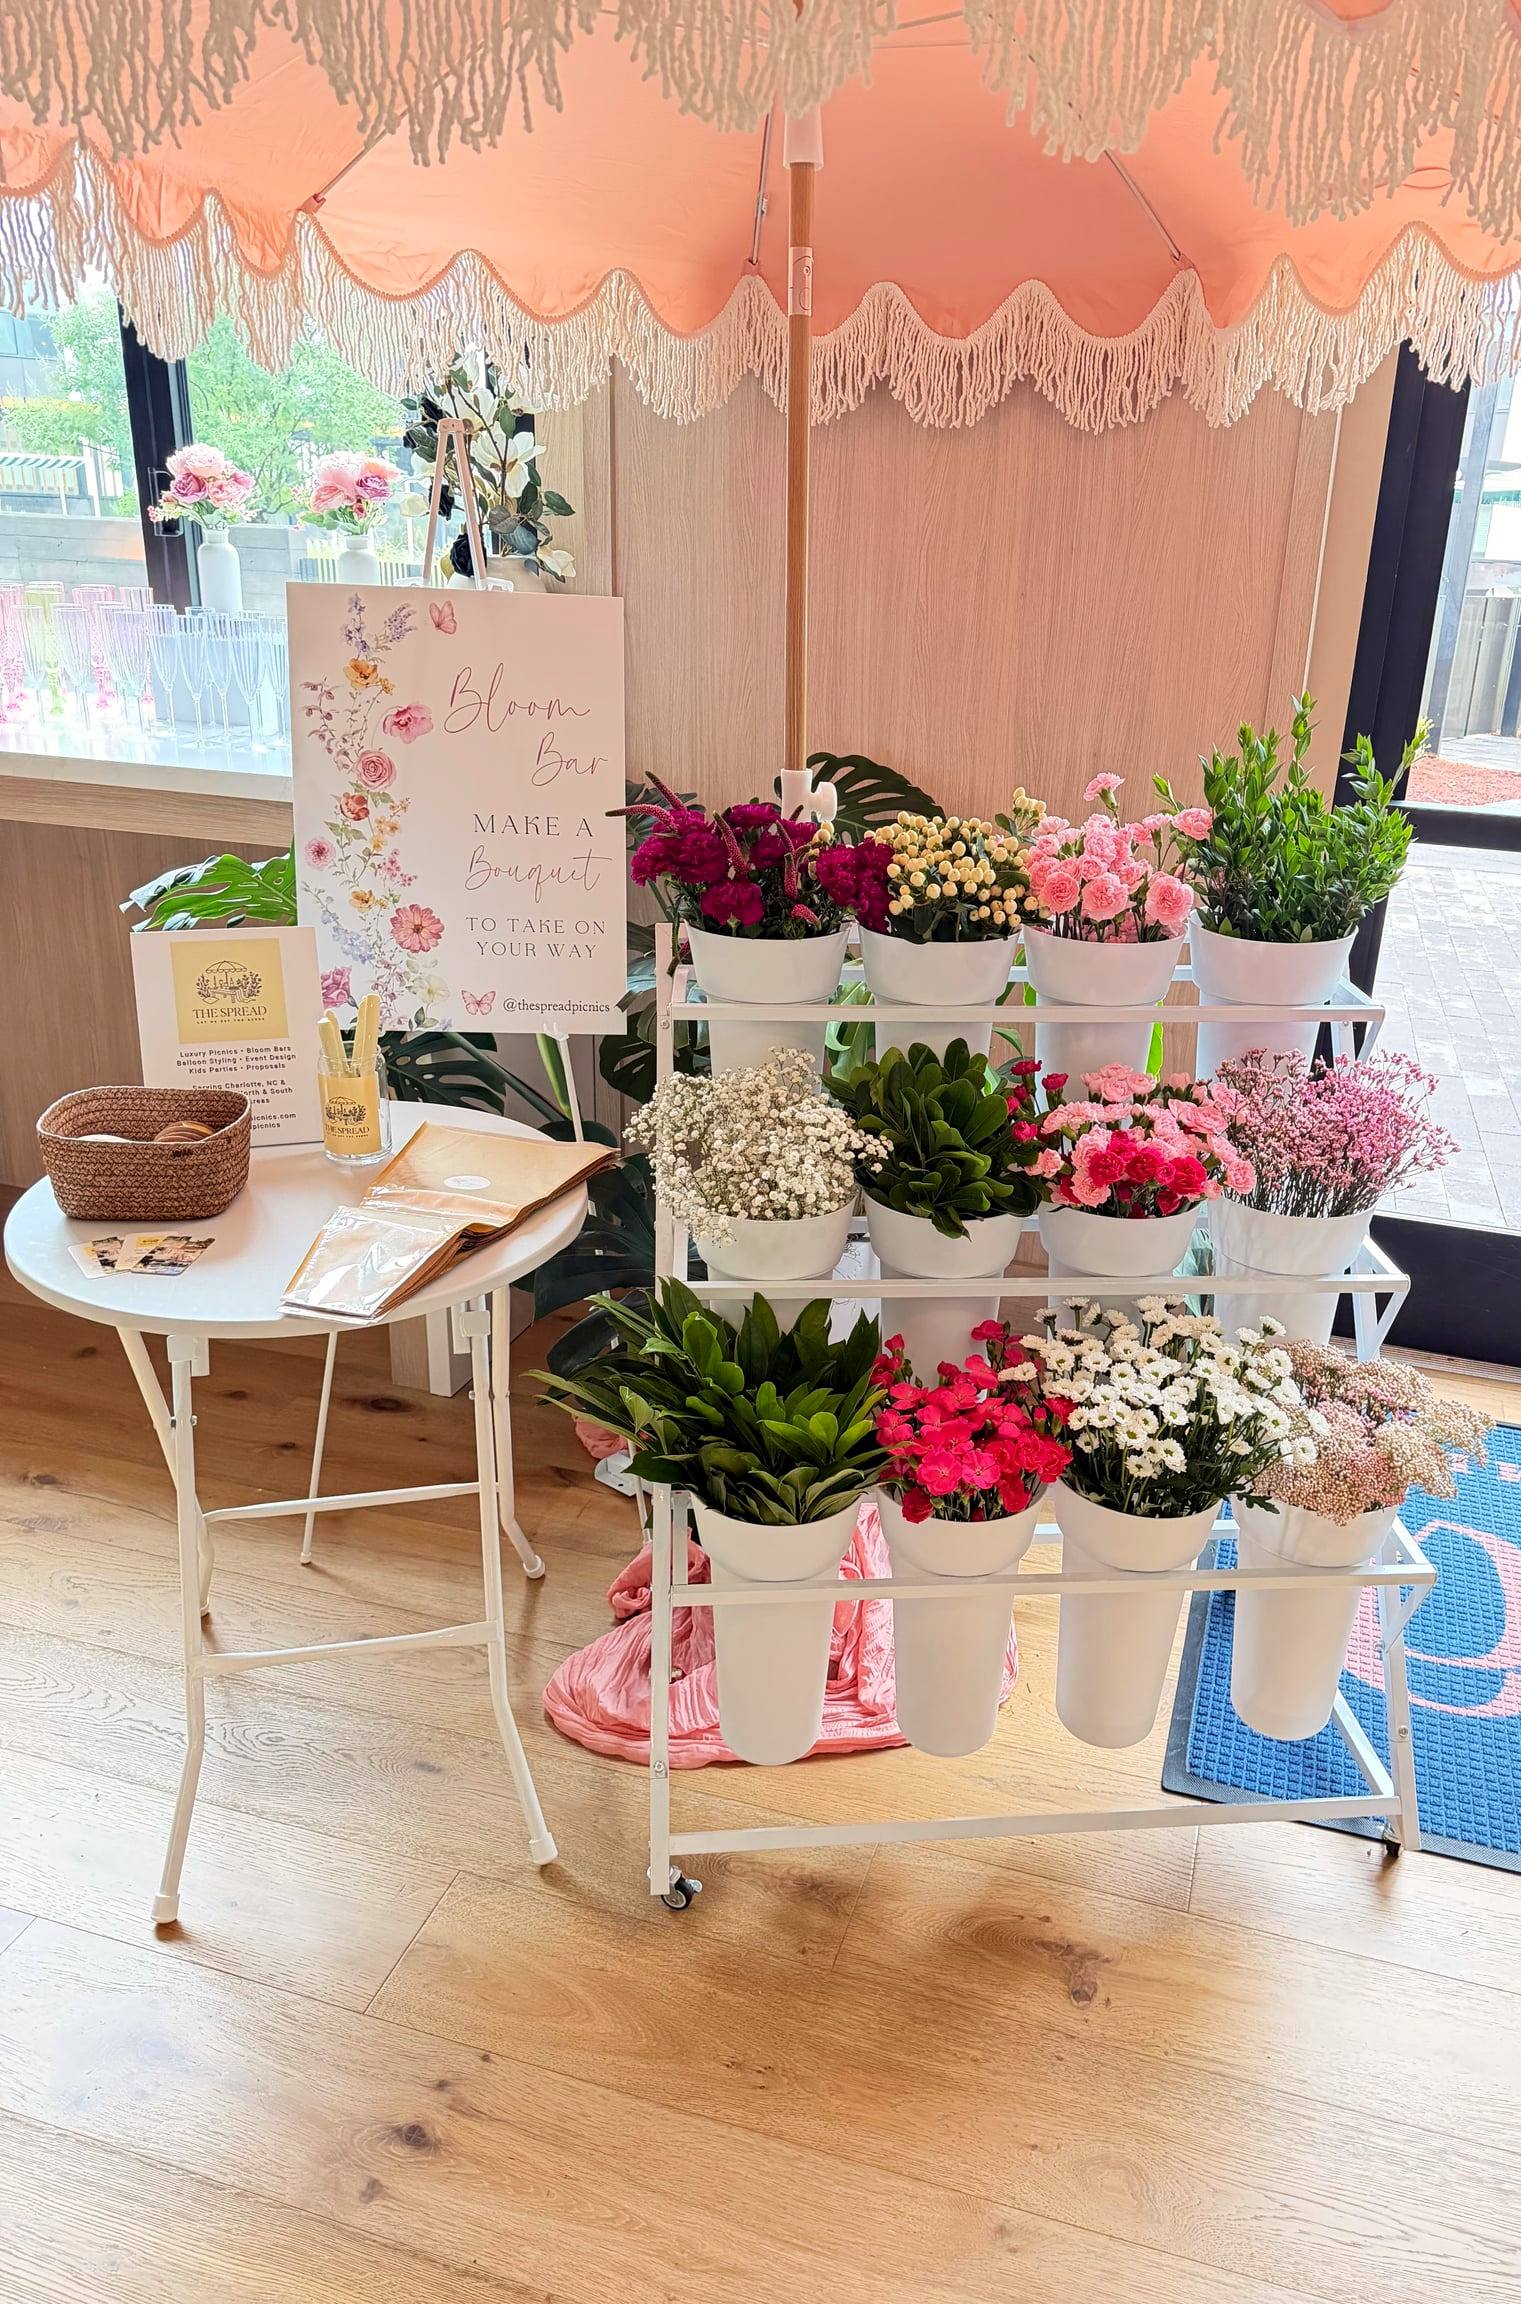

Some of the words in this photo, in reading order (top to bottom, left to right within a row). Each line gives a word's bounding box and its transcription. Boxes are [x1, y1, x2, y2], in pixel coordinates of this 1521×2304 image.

[444, 662, 591, 733] Bloom
[531, 731, 608, 786] Bar
[473, 813, 560, 836] MAKE
[575, 817, 594, 838] A
[464, 844, 613, 903] Bouquet
[465, 916, 497, 932] TO
[506, 918, 565, 934] TAKE
[574, 920, 606, 935] ON
[476, 941, 537, 957] YOUR
[547, 943, 596, 959] WAY
[192, 1008, 219, 1019] THE
[219, 1005, 267, 1018] SPREAD
[503, 998, 610, 1014] @thespreadpicnics
[179, 1050, 207, 1059] Luxury
[273, 1045, 292, 1053] Bars
[176, 1059, 207, 1067] Balloon
[209, 1057, 238, 1066] Styling
[245, 1055, 268, 1063] Event
[269, 1053, 297, 1061] Design
[246, 1063, 287, 1072] Proposals
[224, 1081, 265, 1090] Charlotte,
[270, 1087, 294, 1095] South
[337, 1126, 370, 1135] SPREAD
